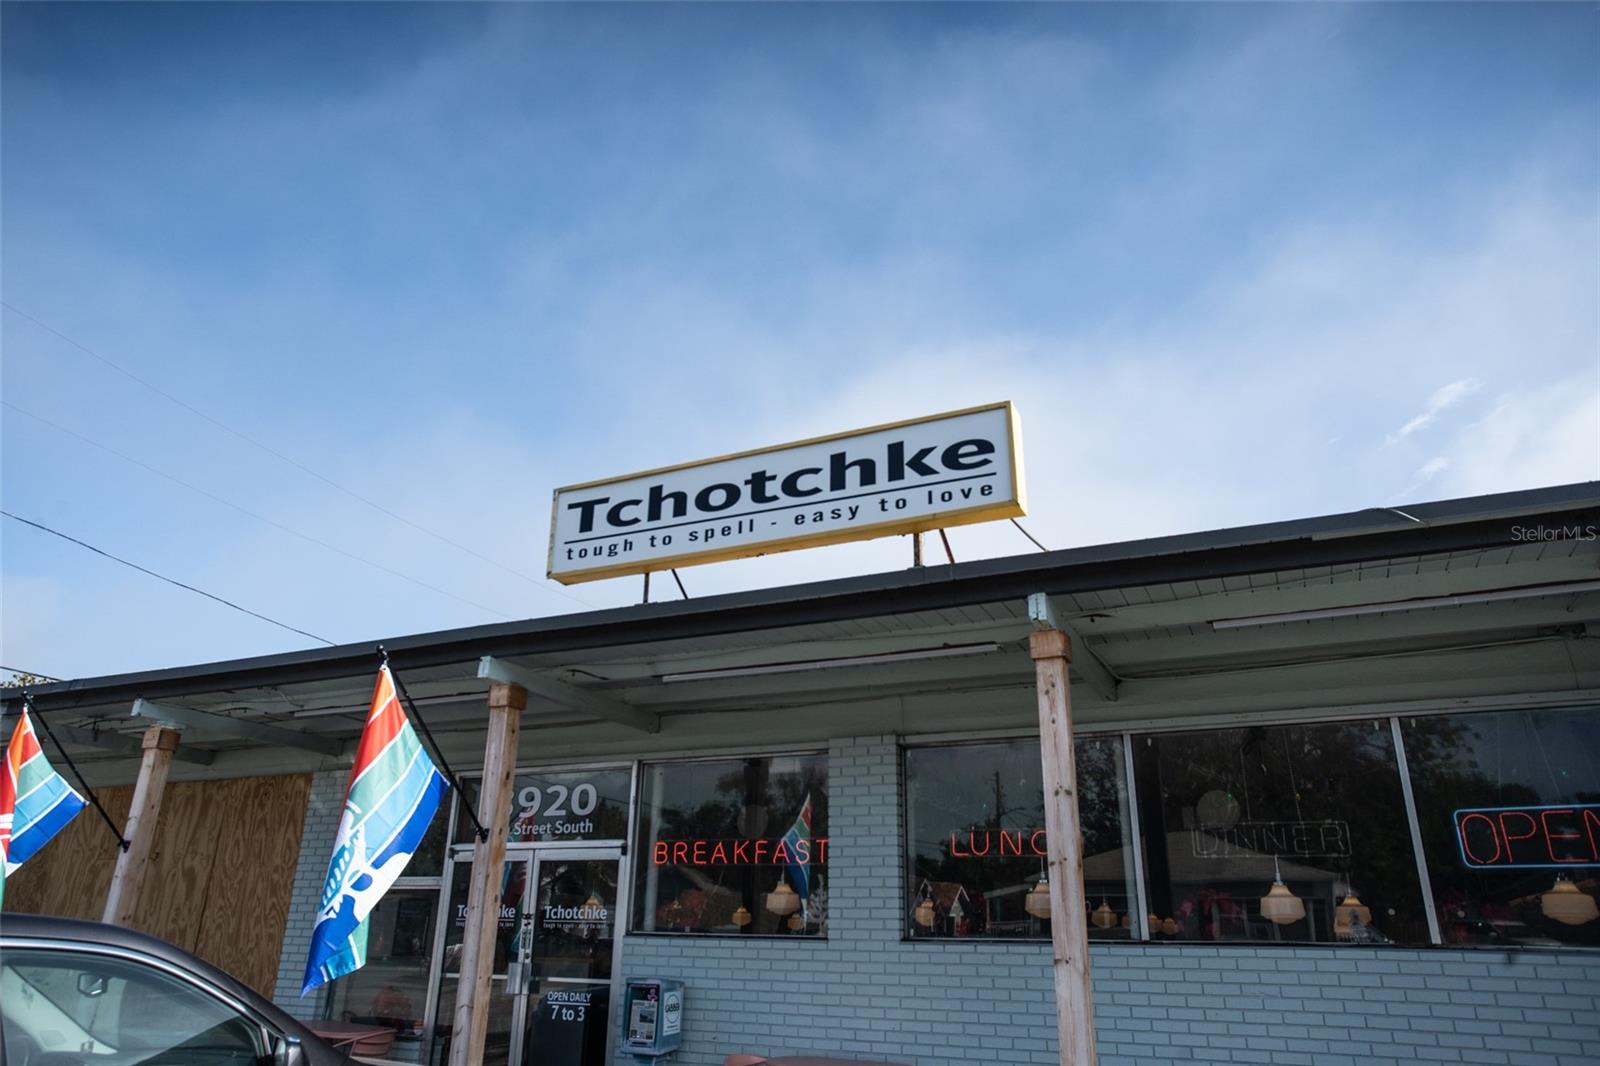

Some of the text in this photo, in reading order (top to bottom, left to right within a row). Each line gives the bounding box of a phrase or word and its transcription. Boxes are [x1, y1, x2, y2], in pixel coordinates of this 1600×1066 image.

[567, 438, 996, 534] Tchotchke
[566, 538, 633, 560] tough
[649, 534, 672, 548] to
[688, 518, 754, 542] spell
[794, 504, 860, 526] easy
[879, 497, 907, 512] to
[928, 483, 993, 505] love
[509, 783, 598, 818] 920
[513, 818, 593, 836] Street South
[1196, 824, 1346, 854] DINNER
[653, 839, 829, 865] BREAKFAST
[951, 830, 1047, 856] LUNC
[544, 904, 608, 920] Tchotchke
[547, 991, 592, 1003] OPEN DAILY
[551, 1004, 585, 1022] 7 to 3
